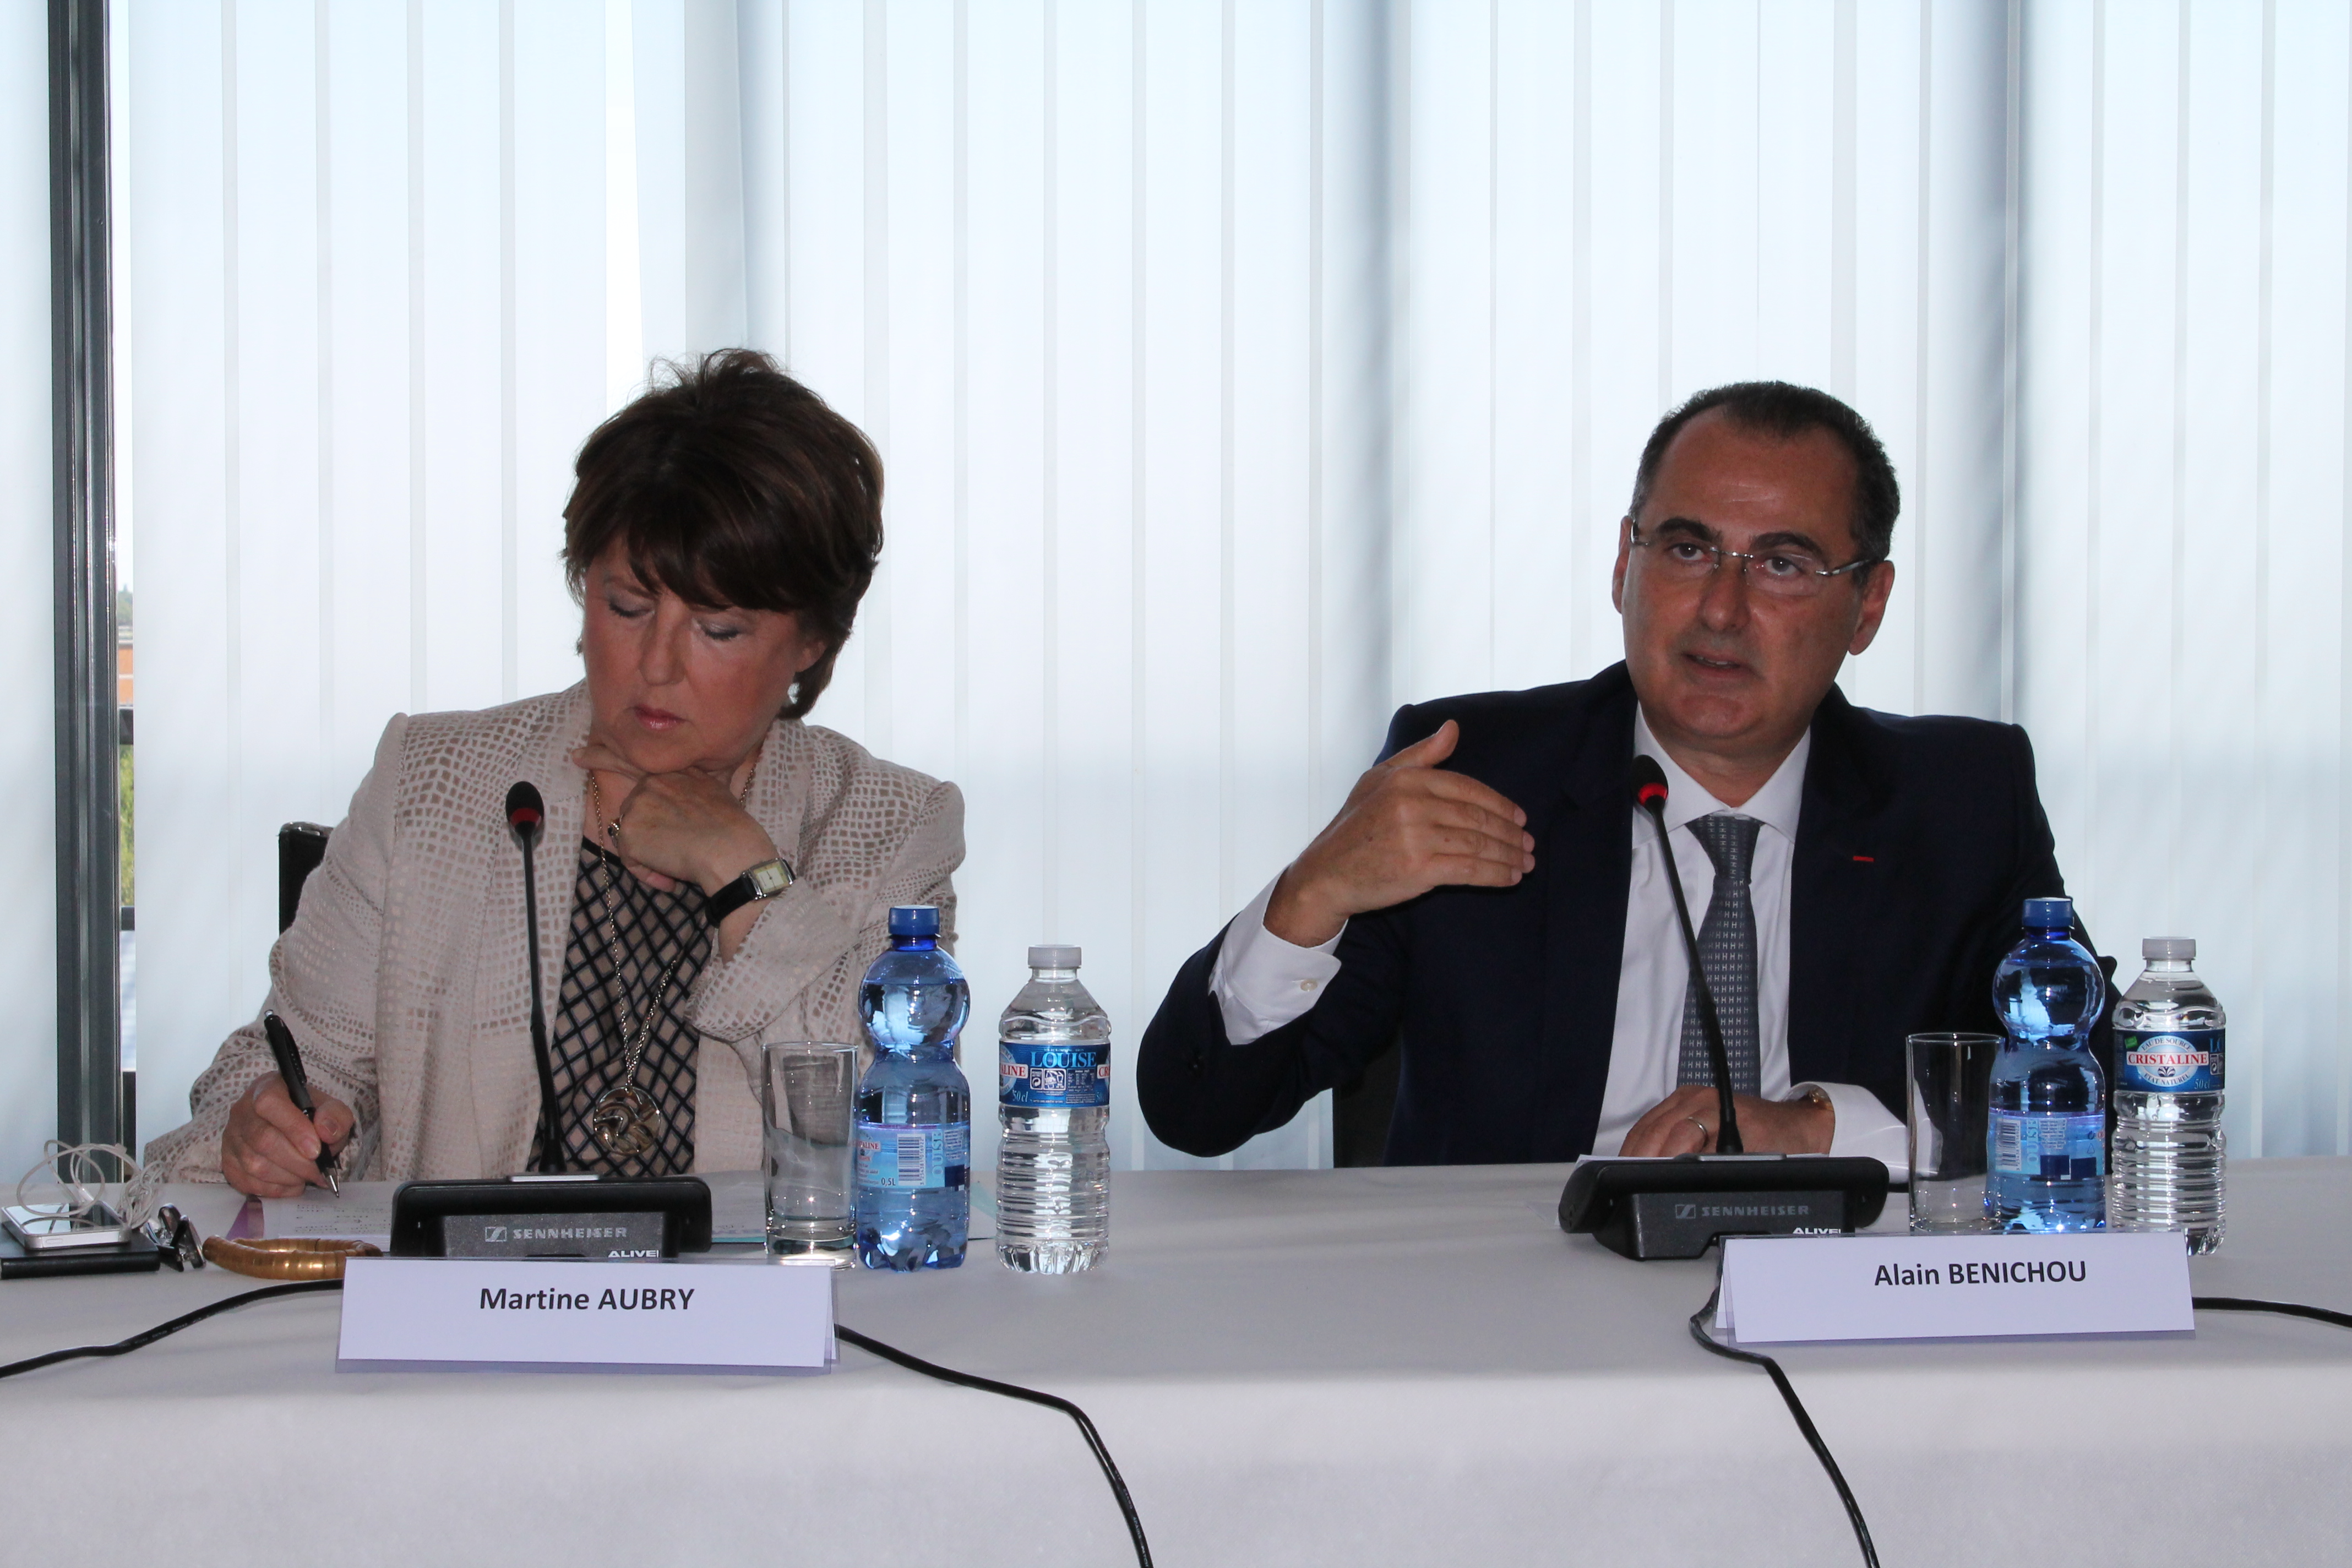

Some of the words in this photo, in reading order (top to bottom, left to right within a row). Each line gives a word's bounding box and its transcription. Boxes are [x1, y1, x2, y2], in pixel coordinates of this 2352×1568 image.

[2141, 1041, 2154, 1050] EAU
[2165, 1038, 2191, 1050] SOURCE
[1031, 1052, 1096, 1068] LOUISE
[2128, 1054, 2207, 1064] CRISTALINE
[2162, 1074, 2189, 1085] NATUREL
[2027, 1119, 2038, 1165] OUISE
[932, 1131, 944, 1179] OUISE
[881, 1177, 896, 1186] 0,5L
[1701, 1205, 1809, 1217] SENNHEISER
[513, 1227, 627, 1239] SENNHEISER
[1874, 1264, 1939, 1286] Alain
[1948, 1261, 2086, 1284] BENICHOU
[480, 1288, 589, 1310] Martine
[598, 1288, 695, 1310] AUBRY
